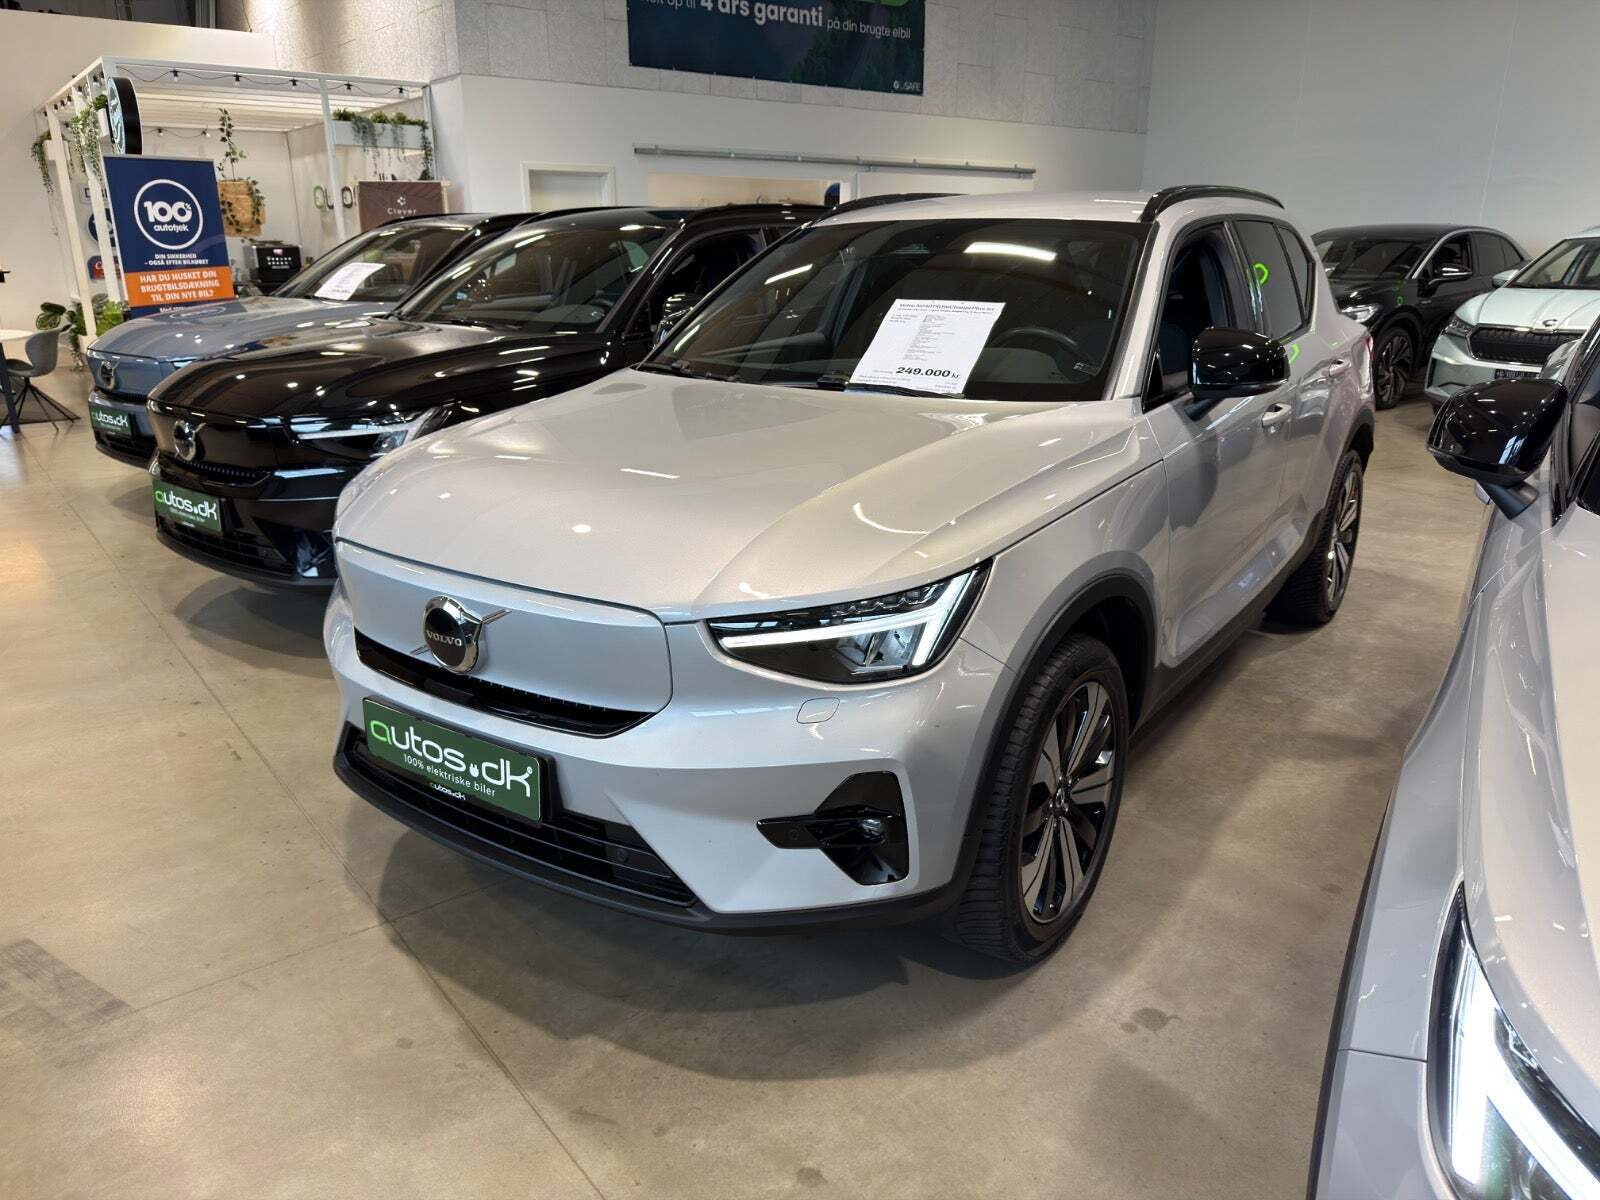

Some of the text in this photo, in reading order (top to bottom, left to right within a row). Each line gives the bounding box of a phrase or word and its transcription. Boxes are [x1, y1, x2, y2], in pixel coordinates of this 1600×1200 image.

[753, 0, 823, 28] garanti
[826, 19, 840, 32] på
[842, 19, 859, 32] din
[859, 22, 891, 40] brugte
[892, 27, 911, 39] elbil
[143, 200, 193, 223] 100%
[153, 223, 189, 233] autotjek
[139, 270, 217, 283] HAR DU HUSKET DIN
[140, 279, 220, 293] BRUGTBILSDÆKNING
[151, 289, 214, 302] TIL DIN NYE BIL?
[895, 366, 951, 378] 249.000
[426, 629, 463, 648] VOLVO
[403, 752, 496, 797] 100% elektriske biler
